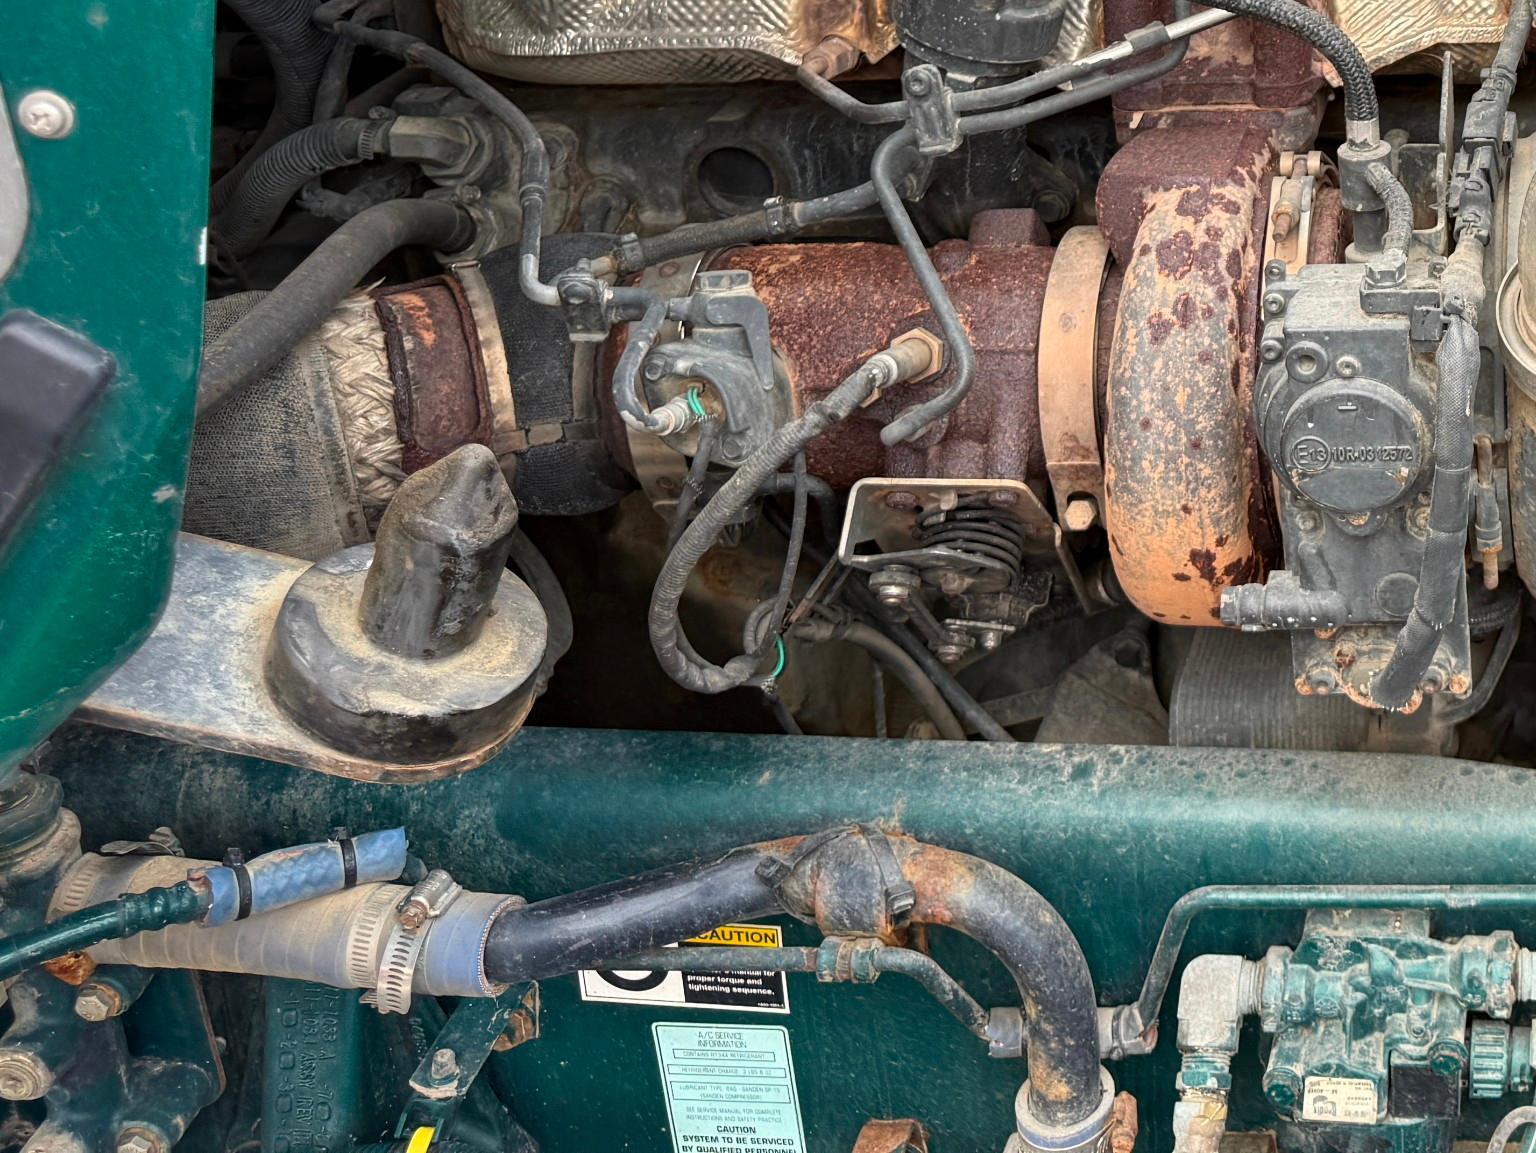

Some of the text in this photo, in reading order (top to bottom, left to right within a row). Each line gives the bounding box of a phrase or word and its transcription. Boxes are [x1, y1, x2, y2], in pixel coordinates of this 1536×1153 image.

[687, 974, 763, 986] proper torque and
[688, 983, 775, 996] tightening sequence.
[698, 1031, 744, 1041] A/C SERVICE
[697, 1040, 748, 1049] INFORMATION
[716, 1125, 757, 1134] CAUTION
[682, 1134, 794, 1146] SYSTEM TO BE SERVICED
[682, 1145, 694, 1153] BY
